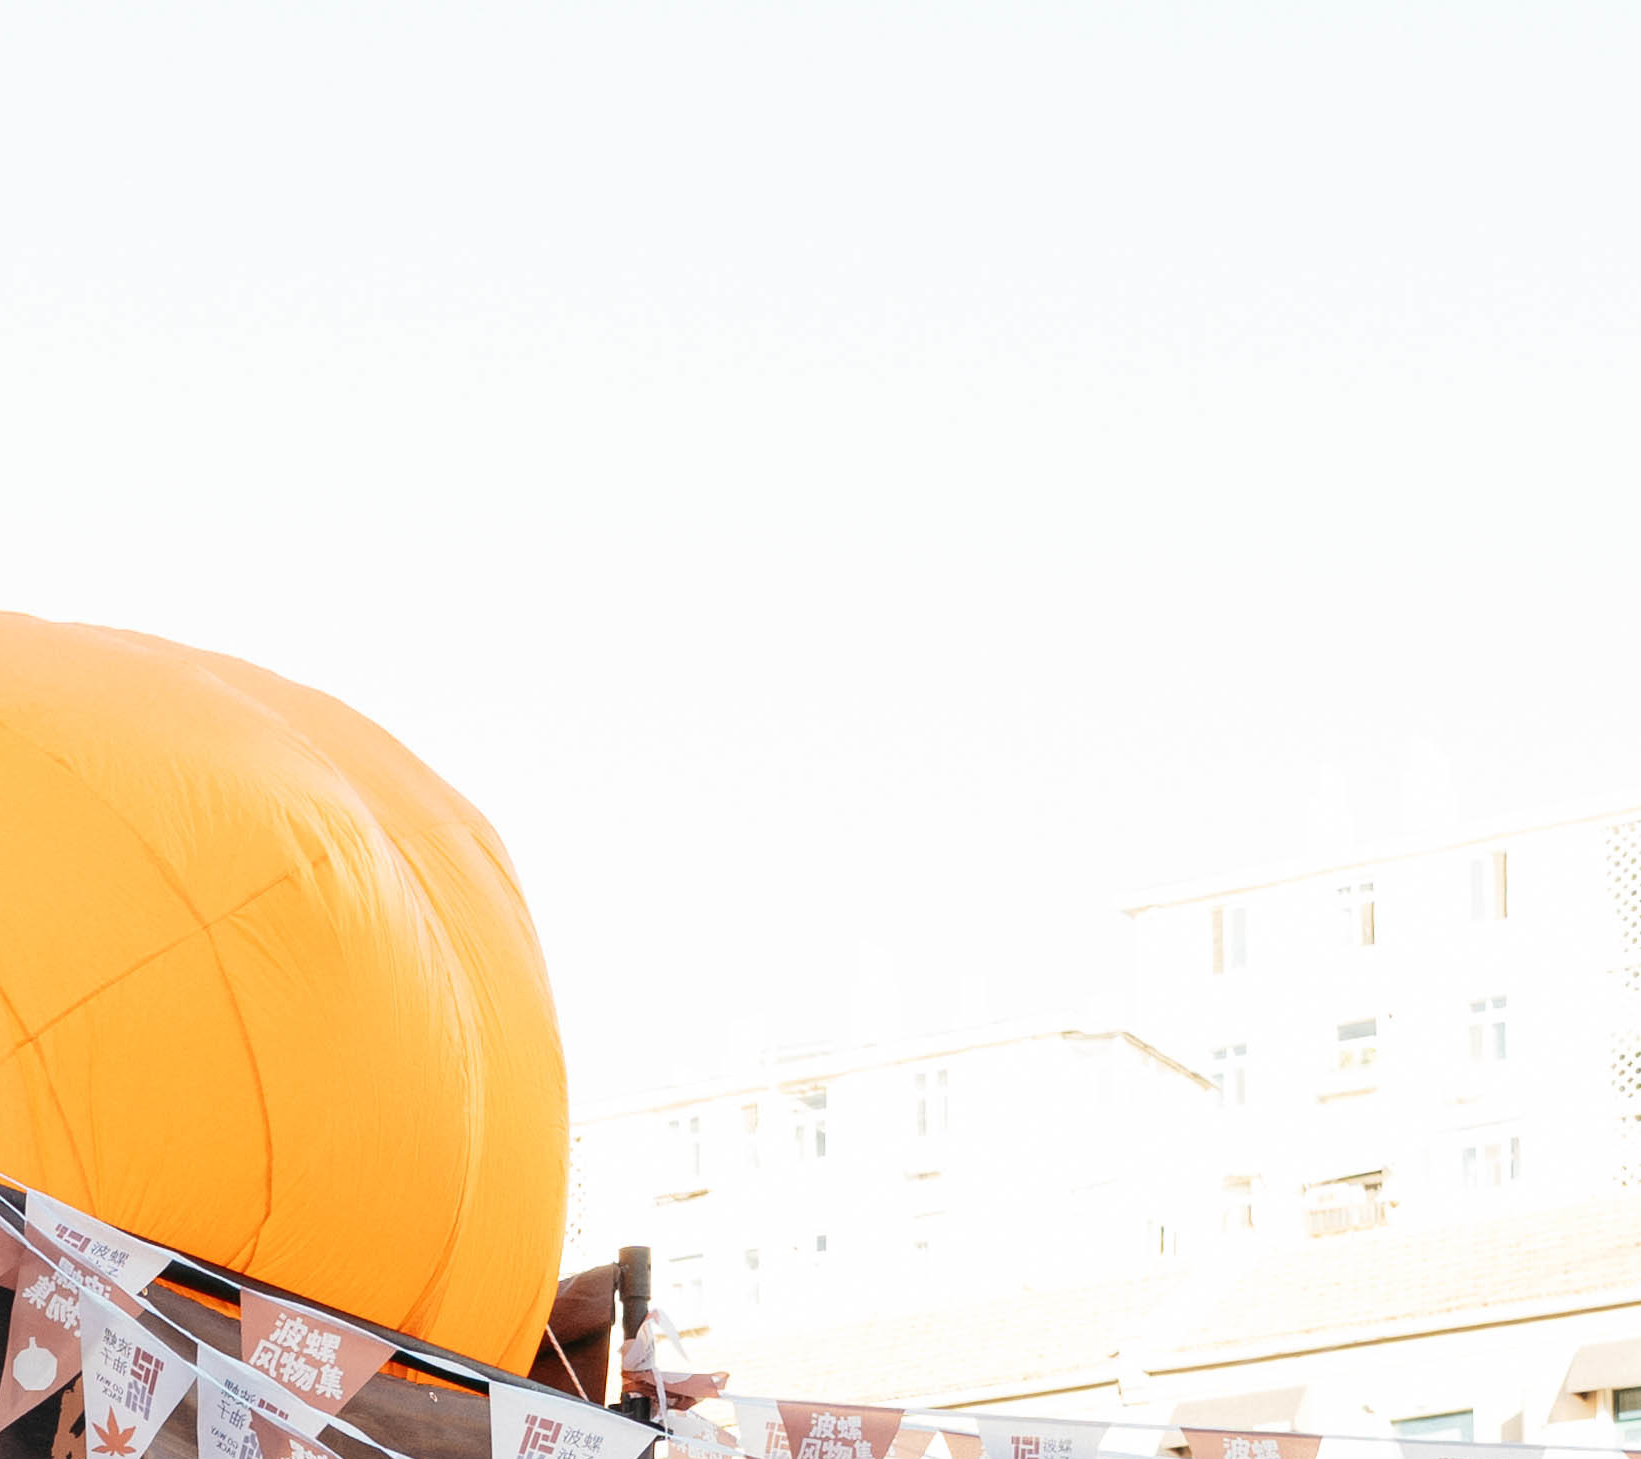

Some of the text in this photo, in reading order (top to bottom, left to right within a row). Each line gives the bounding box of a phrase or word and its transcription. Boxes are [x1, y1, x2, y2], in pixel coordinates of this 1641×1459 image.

[268, 1312, 342, 1364] 波螺
[248, 1339, 345, 1401] 风物集
[563, 1426, 605, 1451] 波螺
[809, 1412, 863, 1439] 波螺
